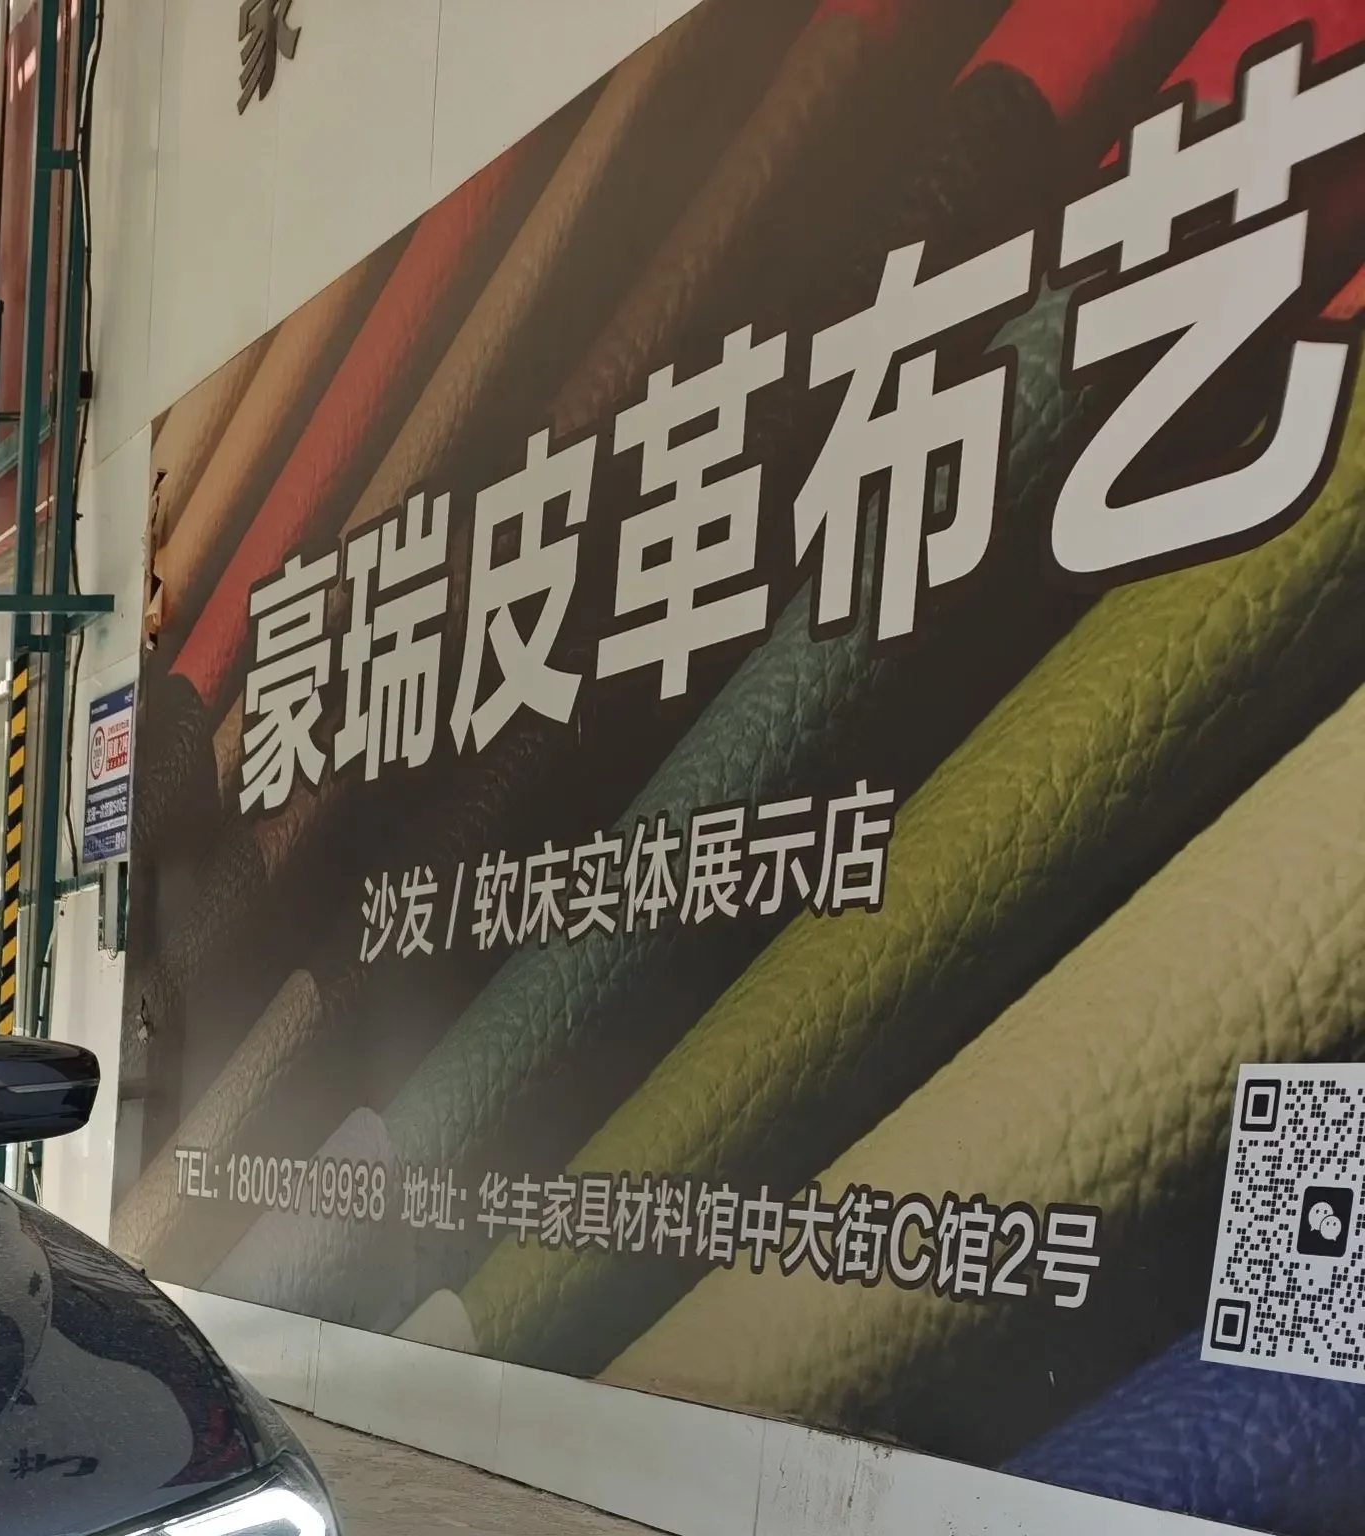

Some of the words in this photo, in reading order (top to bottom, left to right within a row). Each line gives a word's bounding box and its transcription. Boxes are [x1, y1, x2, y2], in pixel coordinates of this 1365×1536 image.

[237, 41, 1365, 815] 豪瑞皮革布艺
[175, 1150, 219, 1198] TEL:
[226, 1154, 386, 1222] 18003719938
[400, 1165, 468, 1231] 地址:
[475, 1171, 1101, 1309] 华丰家具材料馆中大街C馆2号
